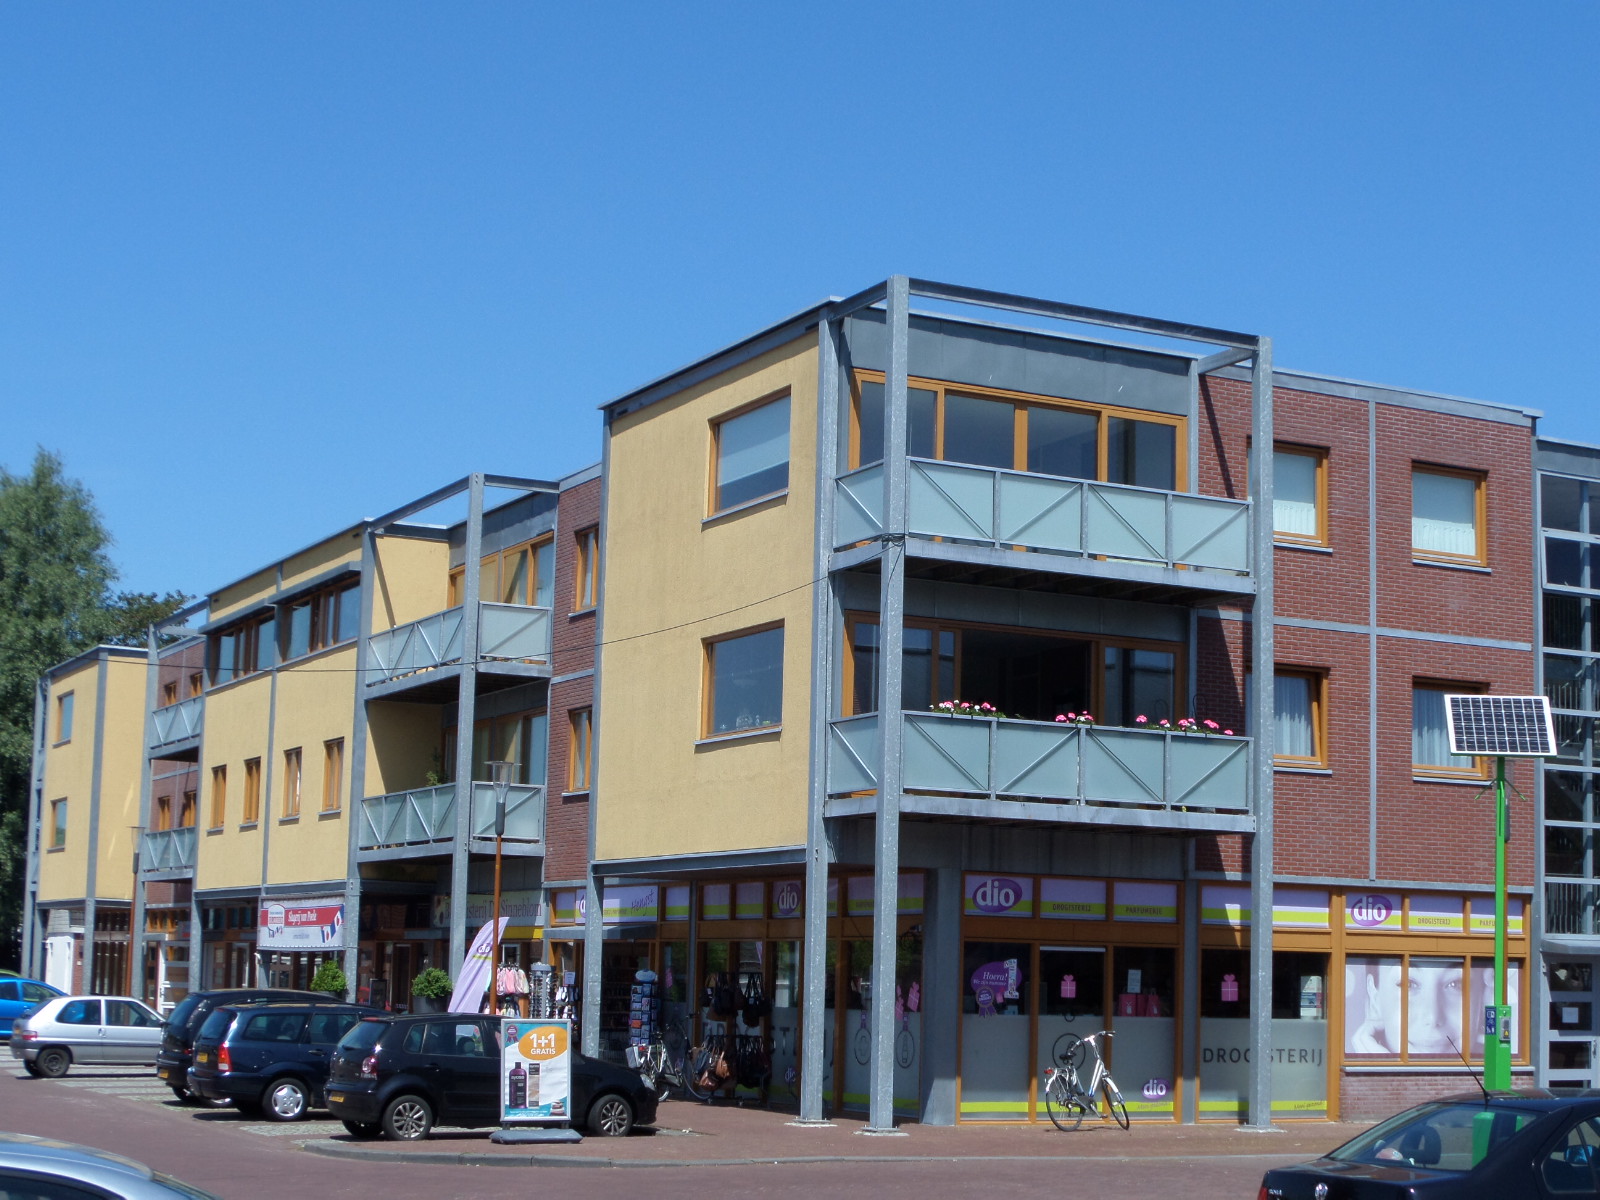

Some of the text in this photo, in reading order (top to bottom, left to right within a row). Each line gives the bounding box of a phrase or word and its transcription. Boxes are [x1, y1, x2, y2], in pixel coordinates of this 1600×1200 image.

[779, 883, 798, 909] dio
[976, 880, 1015, 907] dio
[1052, 903, 1092, 913] DROGISTERIJ
[1125, 906, 1162, 915] PARFUMERIE
[1353, 897, 1387, 921] dio
[1417, 917, 1451, 925] DROGISTERIJ
[983, 971, 1007, 981] Hoera!
[529, 1033, 555, 1048] 1+1
[1143, 1079, 1167, 1095] dio
